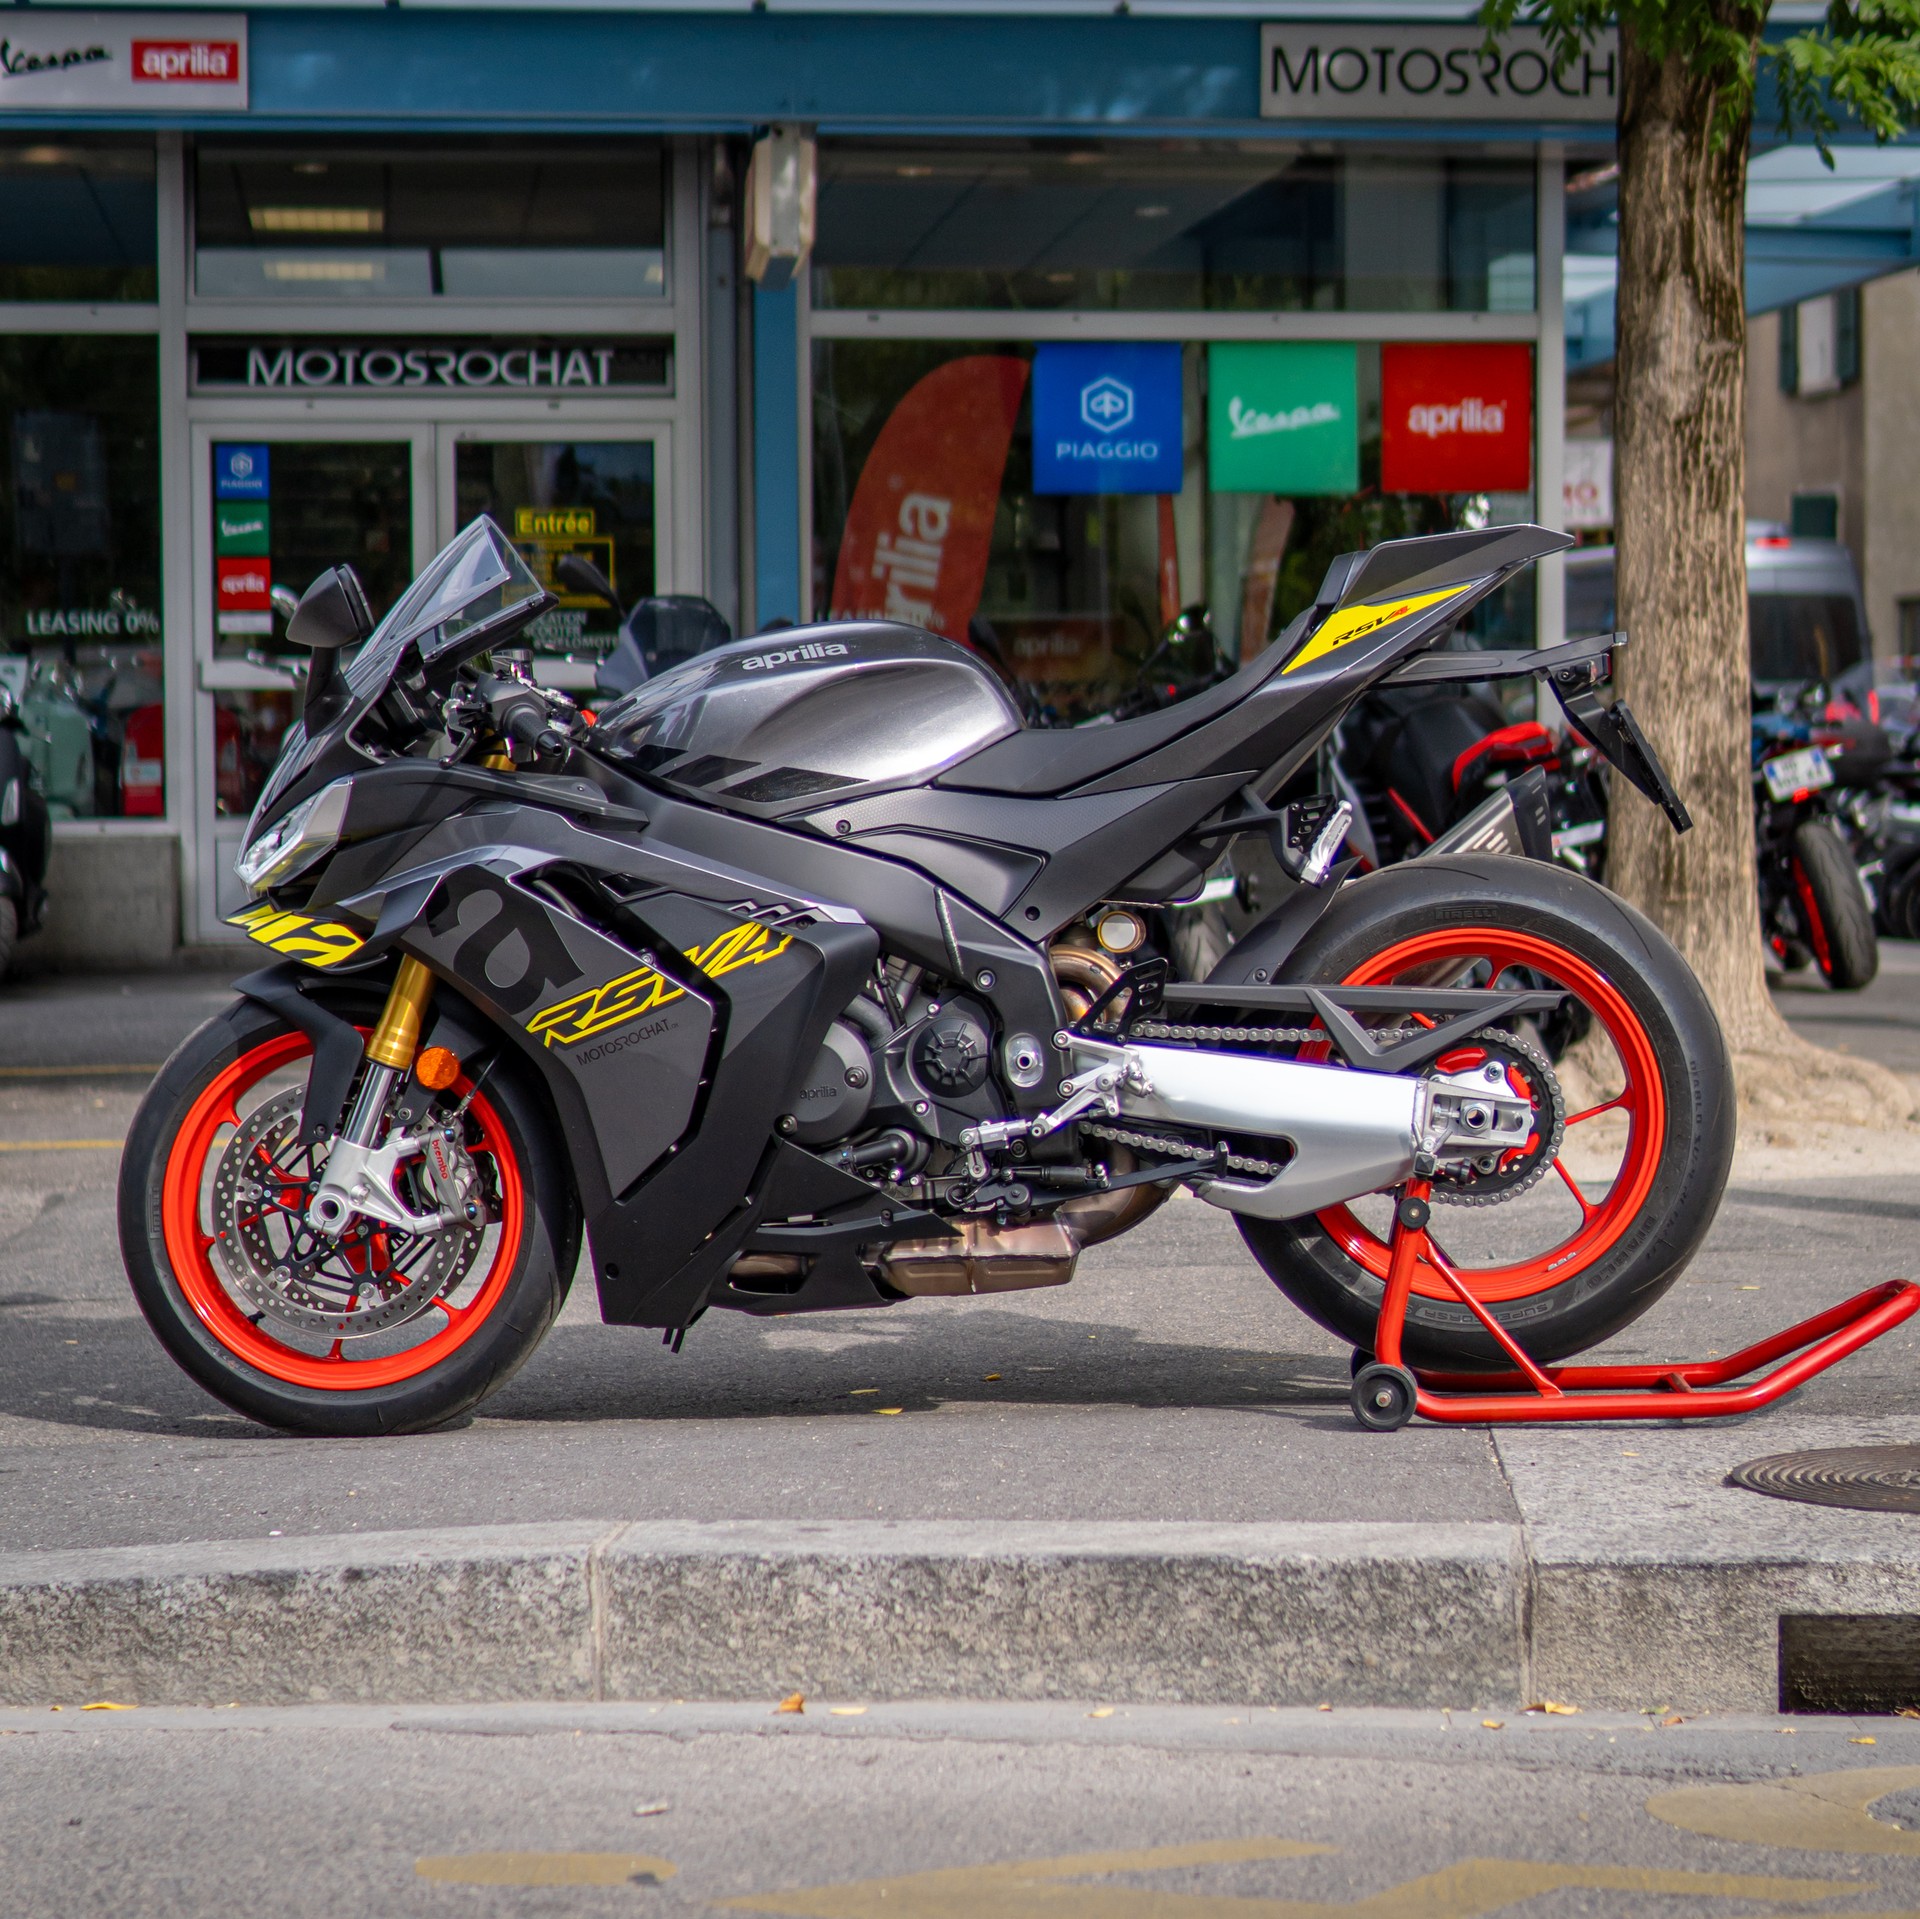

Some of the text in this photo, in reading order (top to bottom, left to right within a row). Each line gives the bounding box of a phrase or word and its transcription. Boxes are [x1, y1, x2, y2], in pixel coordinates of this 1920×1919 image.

[142, 44, 228, 79] aprilia
[1271, 46, 1615, 96] MOTOSROCH
[1228, 396, 1340, 440] Vespa
[1407, 398, 1504, 438] aprilia
[1056, 441, 1158, 460] PIAGGIO
[518, 511, 590, 534] Entrée
[221, 571, 266, 595] aprilia
[27, 610, 159, 635] LEASING 0%
[1332, 605, 1411, 646] RSV4
[742, 643, 848, 671] aprilia
[525, 921, 794, 1048] RSV4
[799, 1085, 837, 1100] aprilia
[431, 1138, 448, 1180] brembo
